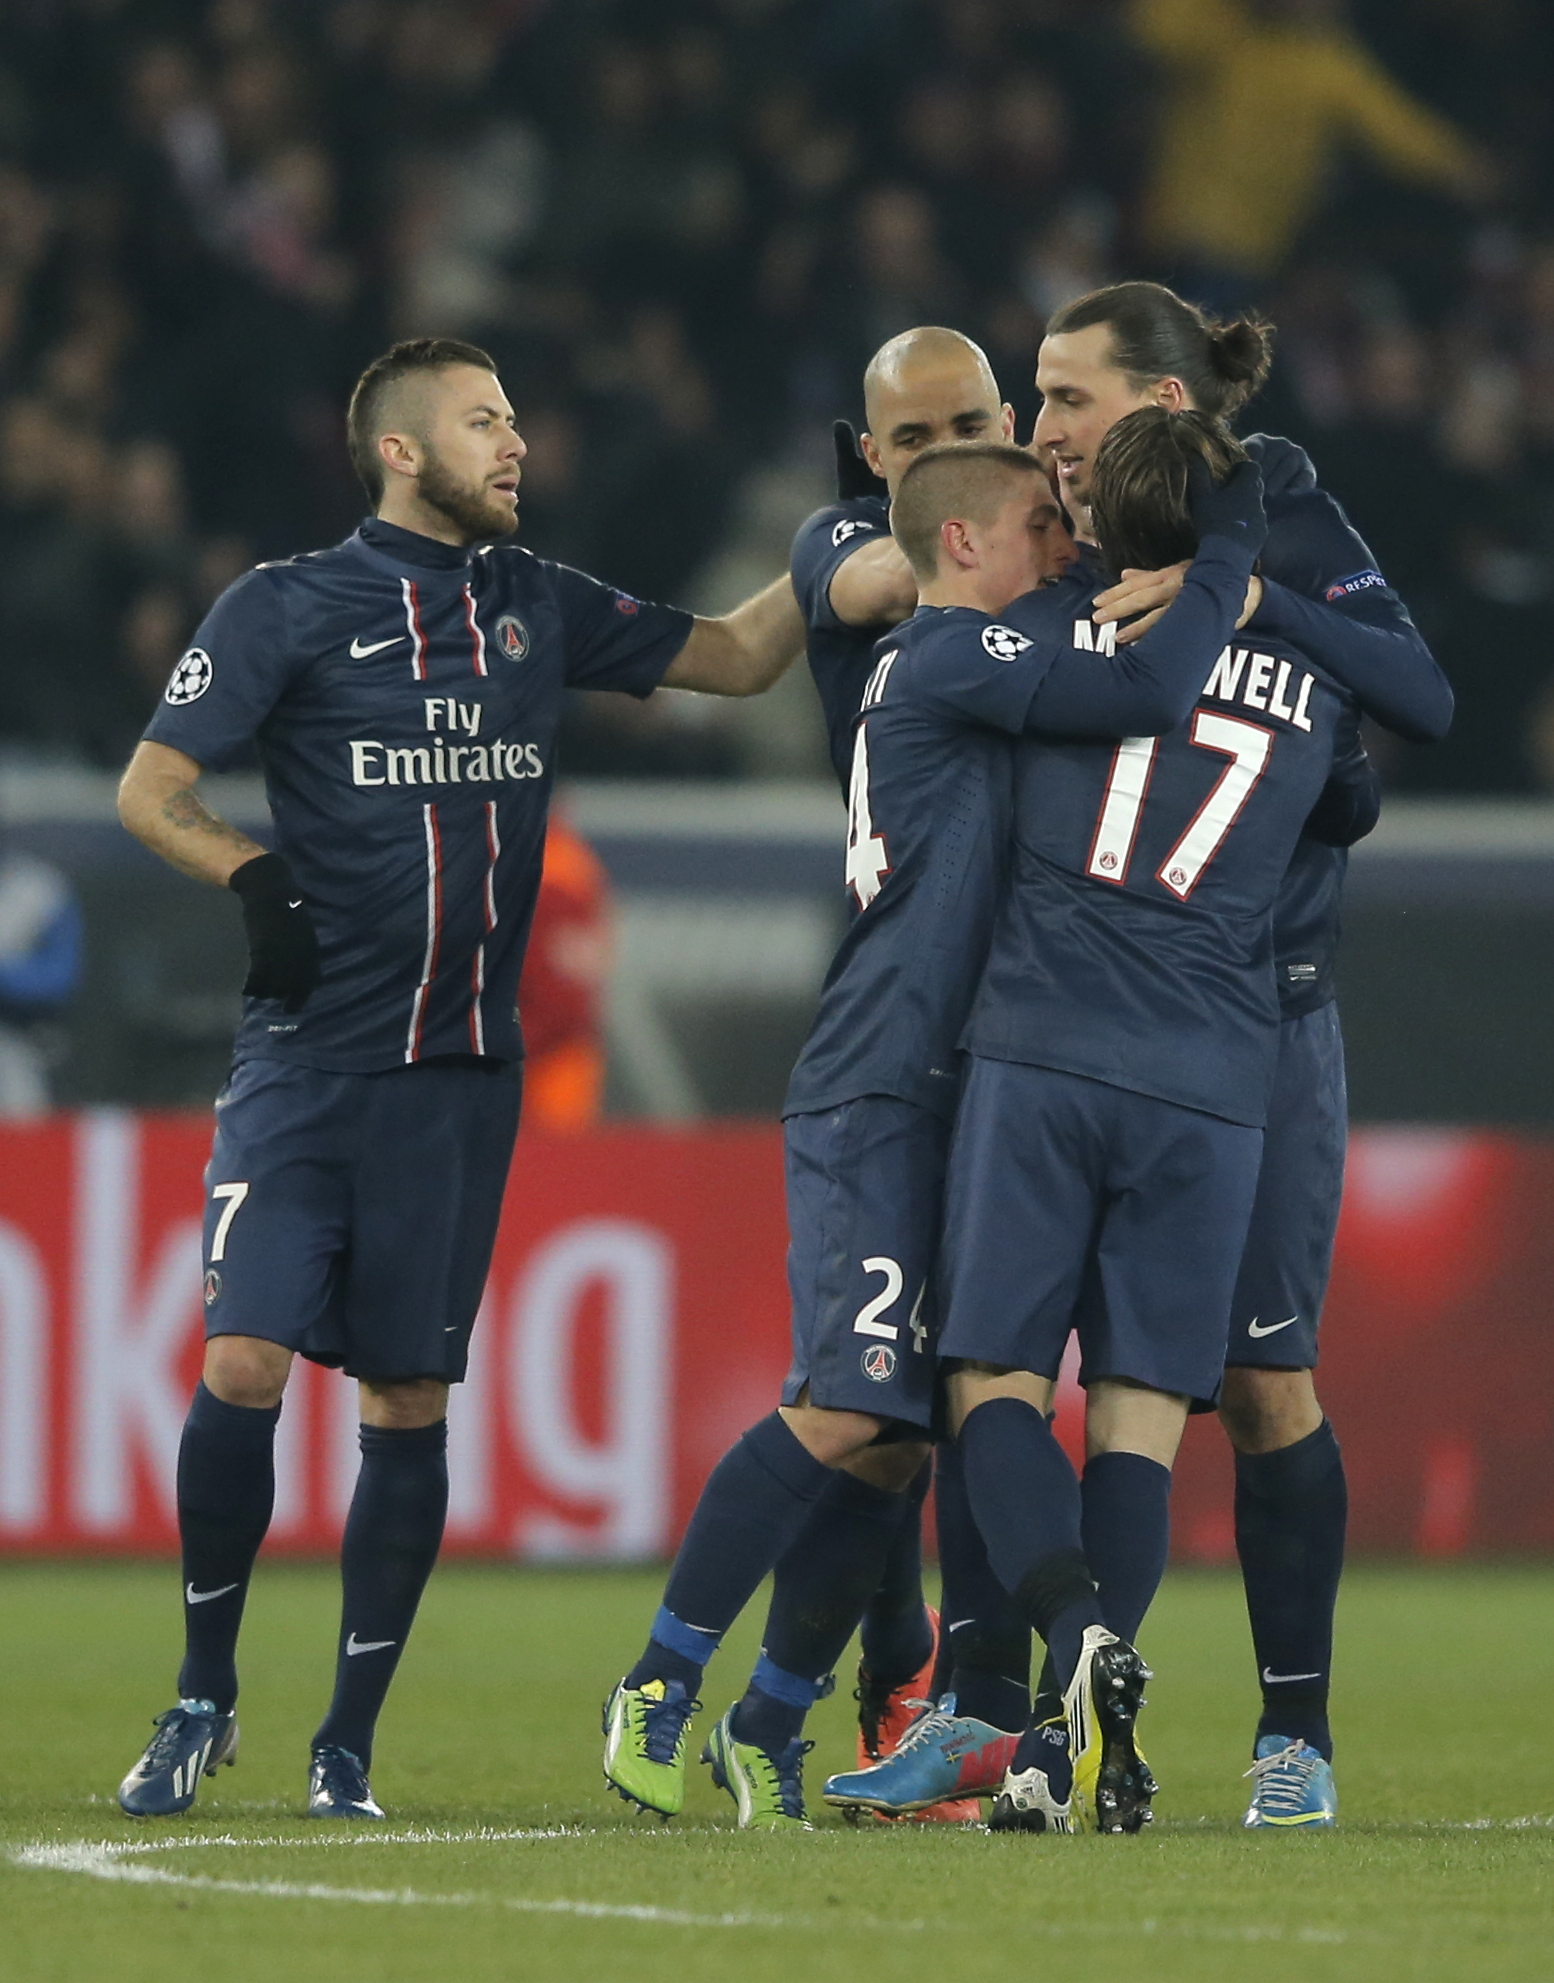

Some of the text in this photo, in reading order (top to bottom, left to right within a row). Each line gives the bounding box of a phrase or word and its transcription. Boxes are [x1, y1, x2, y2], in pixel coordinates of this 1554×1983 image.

[1073, 619, 1316, 733] MWELL
[424, 697, 482, 737] Fly
[349, 737, 544, 786] Emirates
[1085, 707, 1276, 902] 17
[212, 1182, 249, 1262] 7
[853, 1255, 929, 1354] 24
[1041, 1725, 1067, 1746] PSG
